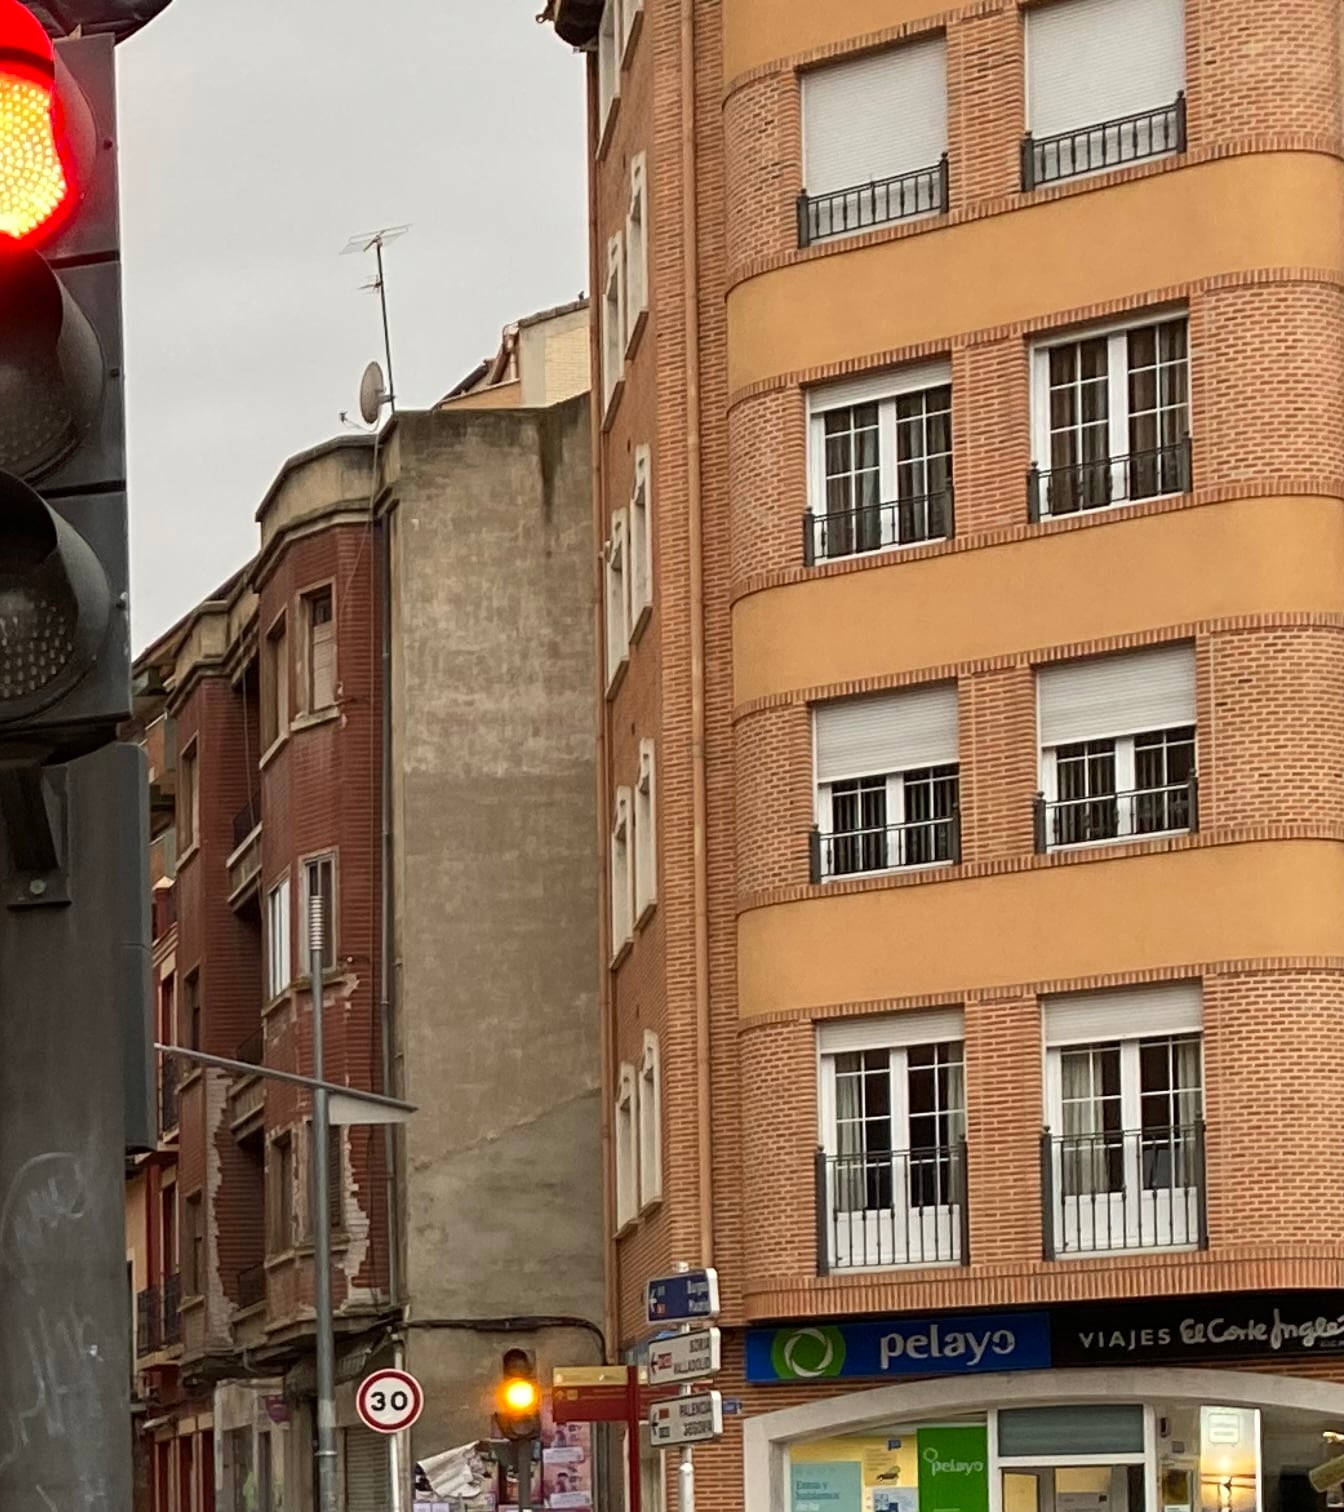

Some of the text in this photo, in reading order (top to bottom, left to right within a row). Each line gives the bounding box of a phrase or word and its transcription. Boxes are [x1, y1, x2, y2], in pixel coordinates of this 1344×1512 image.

[880, 1323, 1016, 1370] pelayo
[1078, 1328, 1172, 1350] VIAJES
[371, 1391, 408, 1411] 30
[931, 1459, 984, 1476] pelayo
